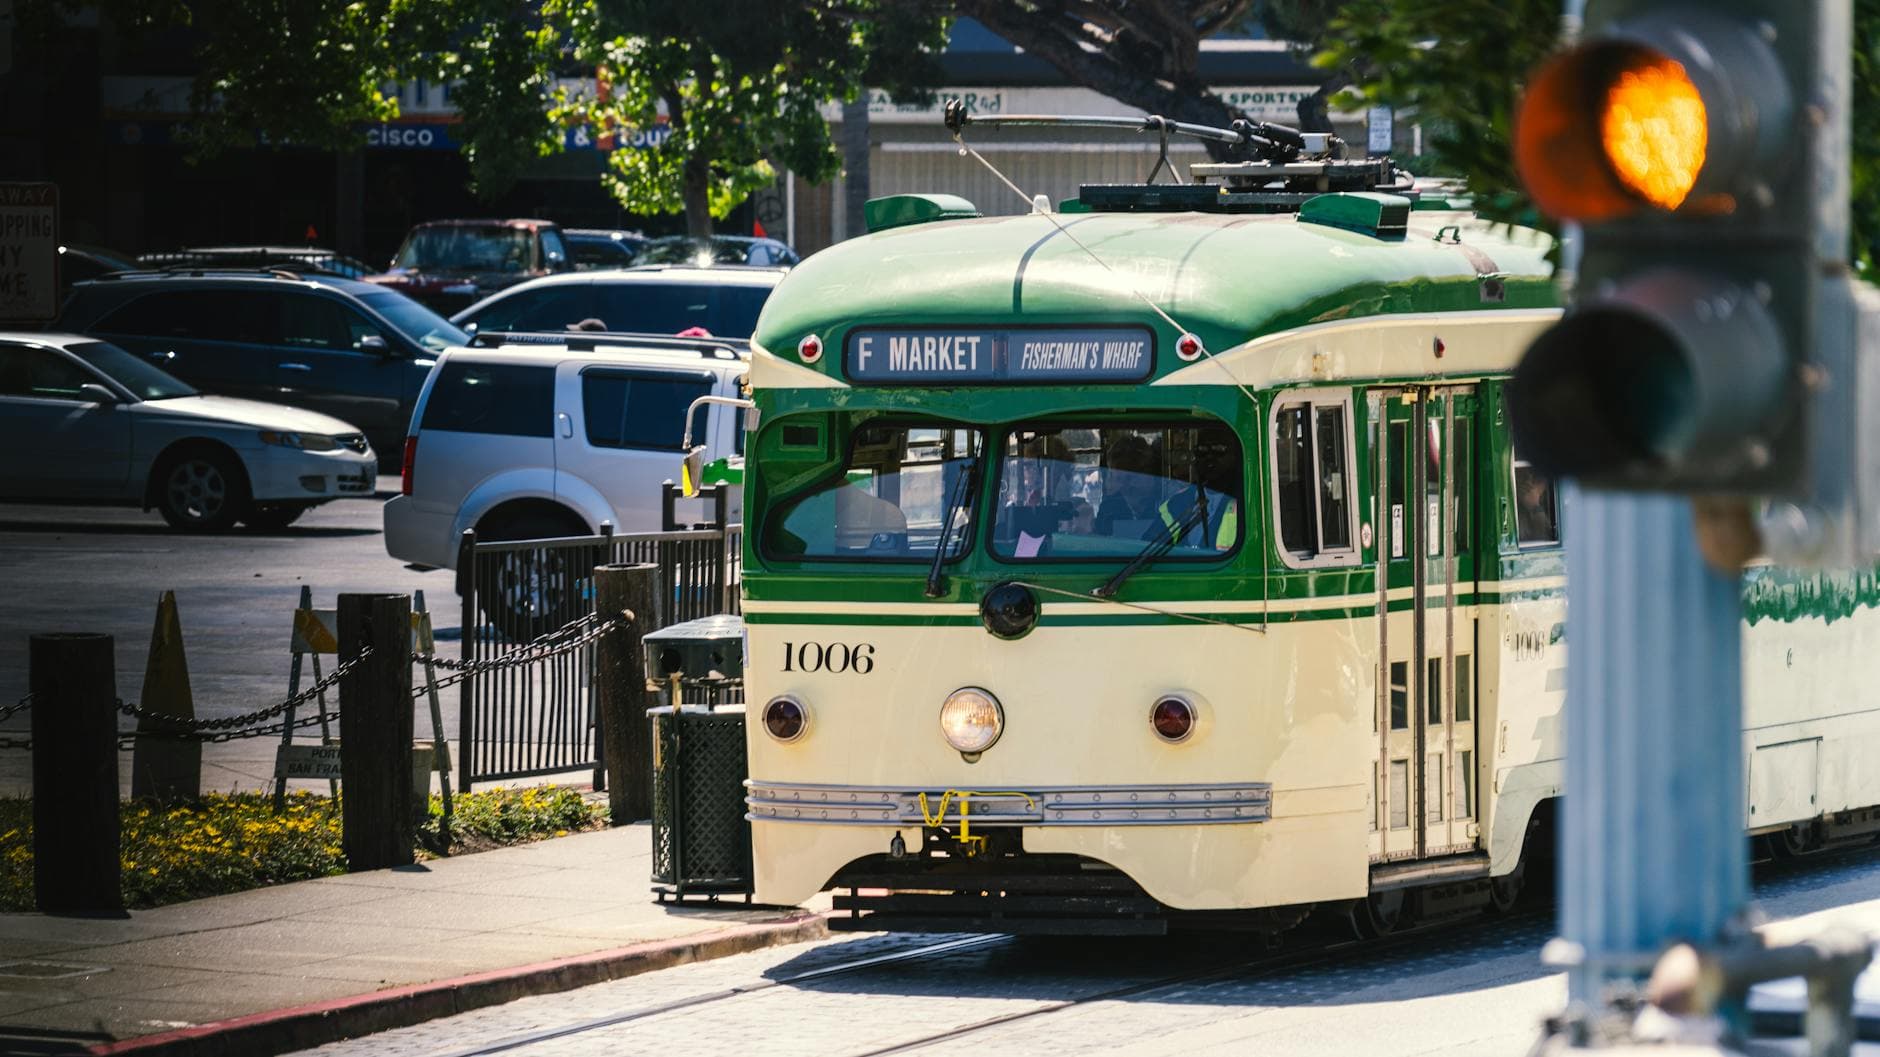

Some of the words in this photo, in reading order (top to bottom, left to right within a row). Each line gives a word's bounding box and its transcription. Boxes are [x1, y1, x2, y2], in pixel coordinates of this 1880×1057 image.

[505, 335, 566, 344] PATHFINDER
[858, 337, 873, 372] F
[889, 336, 981, 371] MARKET
[1021, 341, 1099, 370] FISHERMAN'S
[1102, 341, 1144, 370] WHARF
[779, 641, 875, 675] 1006
[1515, 630, 1545, 662] 1006
[288, 762, 312, 774] SAN
